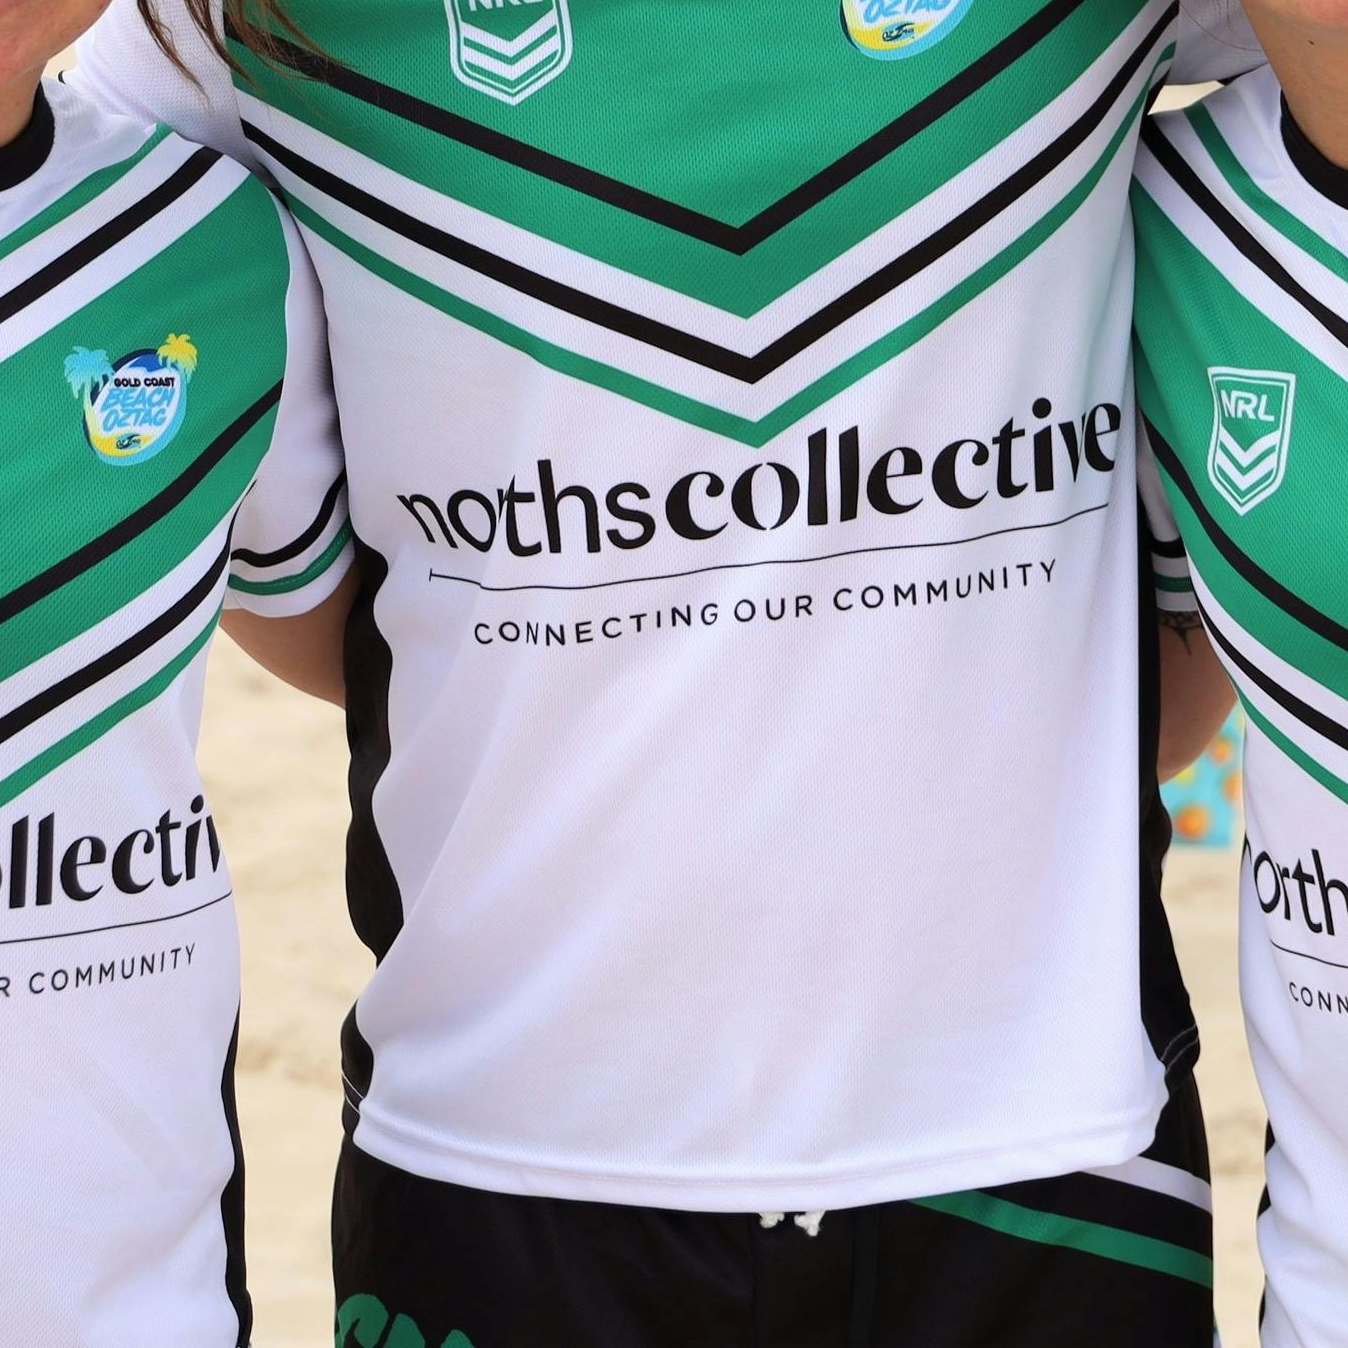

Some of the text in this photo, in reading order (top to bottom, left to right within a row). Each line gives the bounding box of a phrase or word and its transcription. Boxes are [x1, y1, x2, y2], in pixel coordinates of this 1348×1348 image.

[114, 377, 175, 387] GOLD COAST
[102, 408, 167, 432] OZTAG
[1221, 389, 1275, 422] NRL
[474, 558, 1055, 646] CONNECTING OUR COMMUNITY
[29, 943, 195, 995] COMMUNITY
